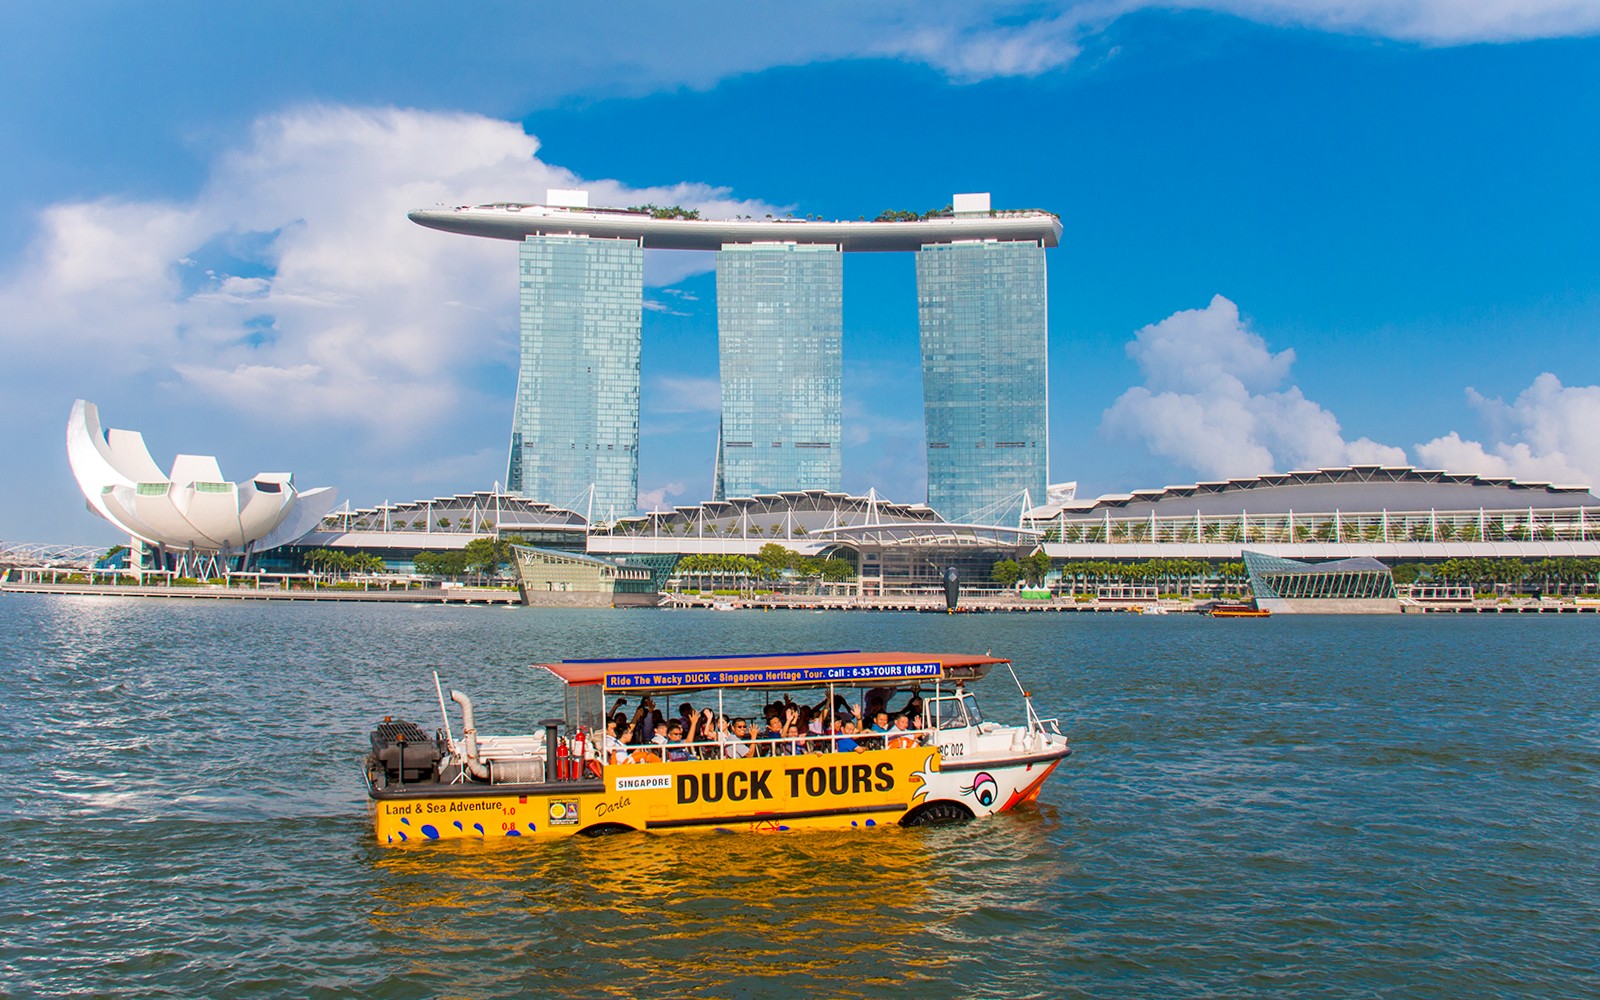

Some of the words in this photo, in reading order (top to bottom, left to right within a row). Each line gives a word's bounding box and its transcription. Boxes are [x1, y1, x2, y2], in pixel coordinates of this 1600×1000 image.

[610, 676, 631, 686] Ride
[634, 675, 650, 685] The
[653, 674, 682, 685] Wacky
[685, 673, 710, 683] DUCK
[719, 672, 763, 683] Singapore
[765, 670, 801, 681] Heritage
[804, 670, 825, 679] Tour.
[828, 669, 845, 677] Call
[852, 666, 902, 677] 6-33-TOURS
[904, 665, 937, 675] (868-77)
[951, 743, 964, 756] 002
[618, 778, 669, 789] SINGAPORE
[677, 769, 774, 805] DUCK
[785, 762, 895, 798] TOURS
[386, 804, 412, 815] Land
[415, 803, 423, 813] &
[426, 802, 446, 813] Sea
[449, 800, 502, 812] Adventure
[502, 807, 516, 816] 1.0
[594, 796, 632, 817] Darla
[501, 822, 516, 831] 0.8
